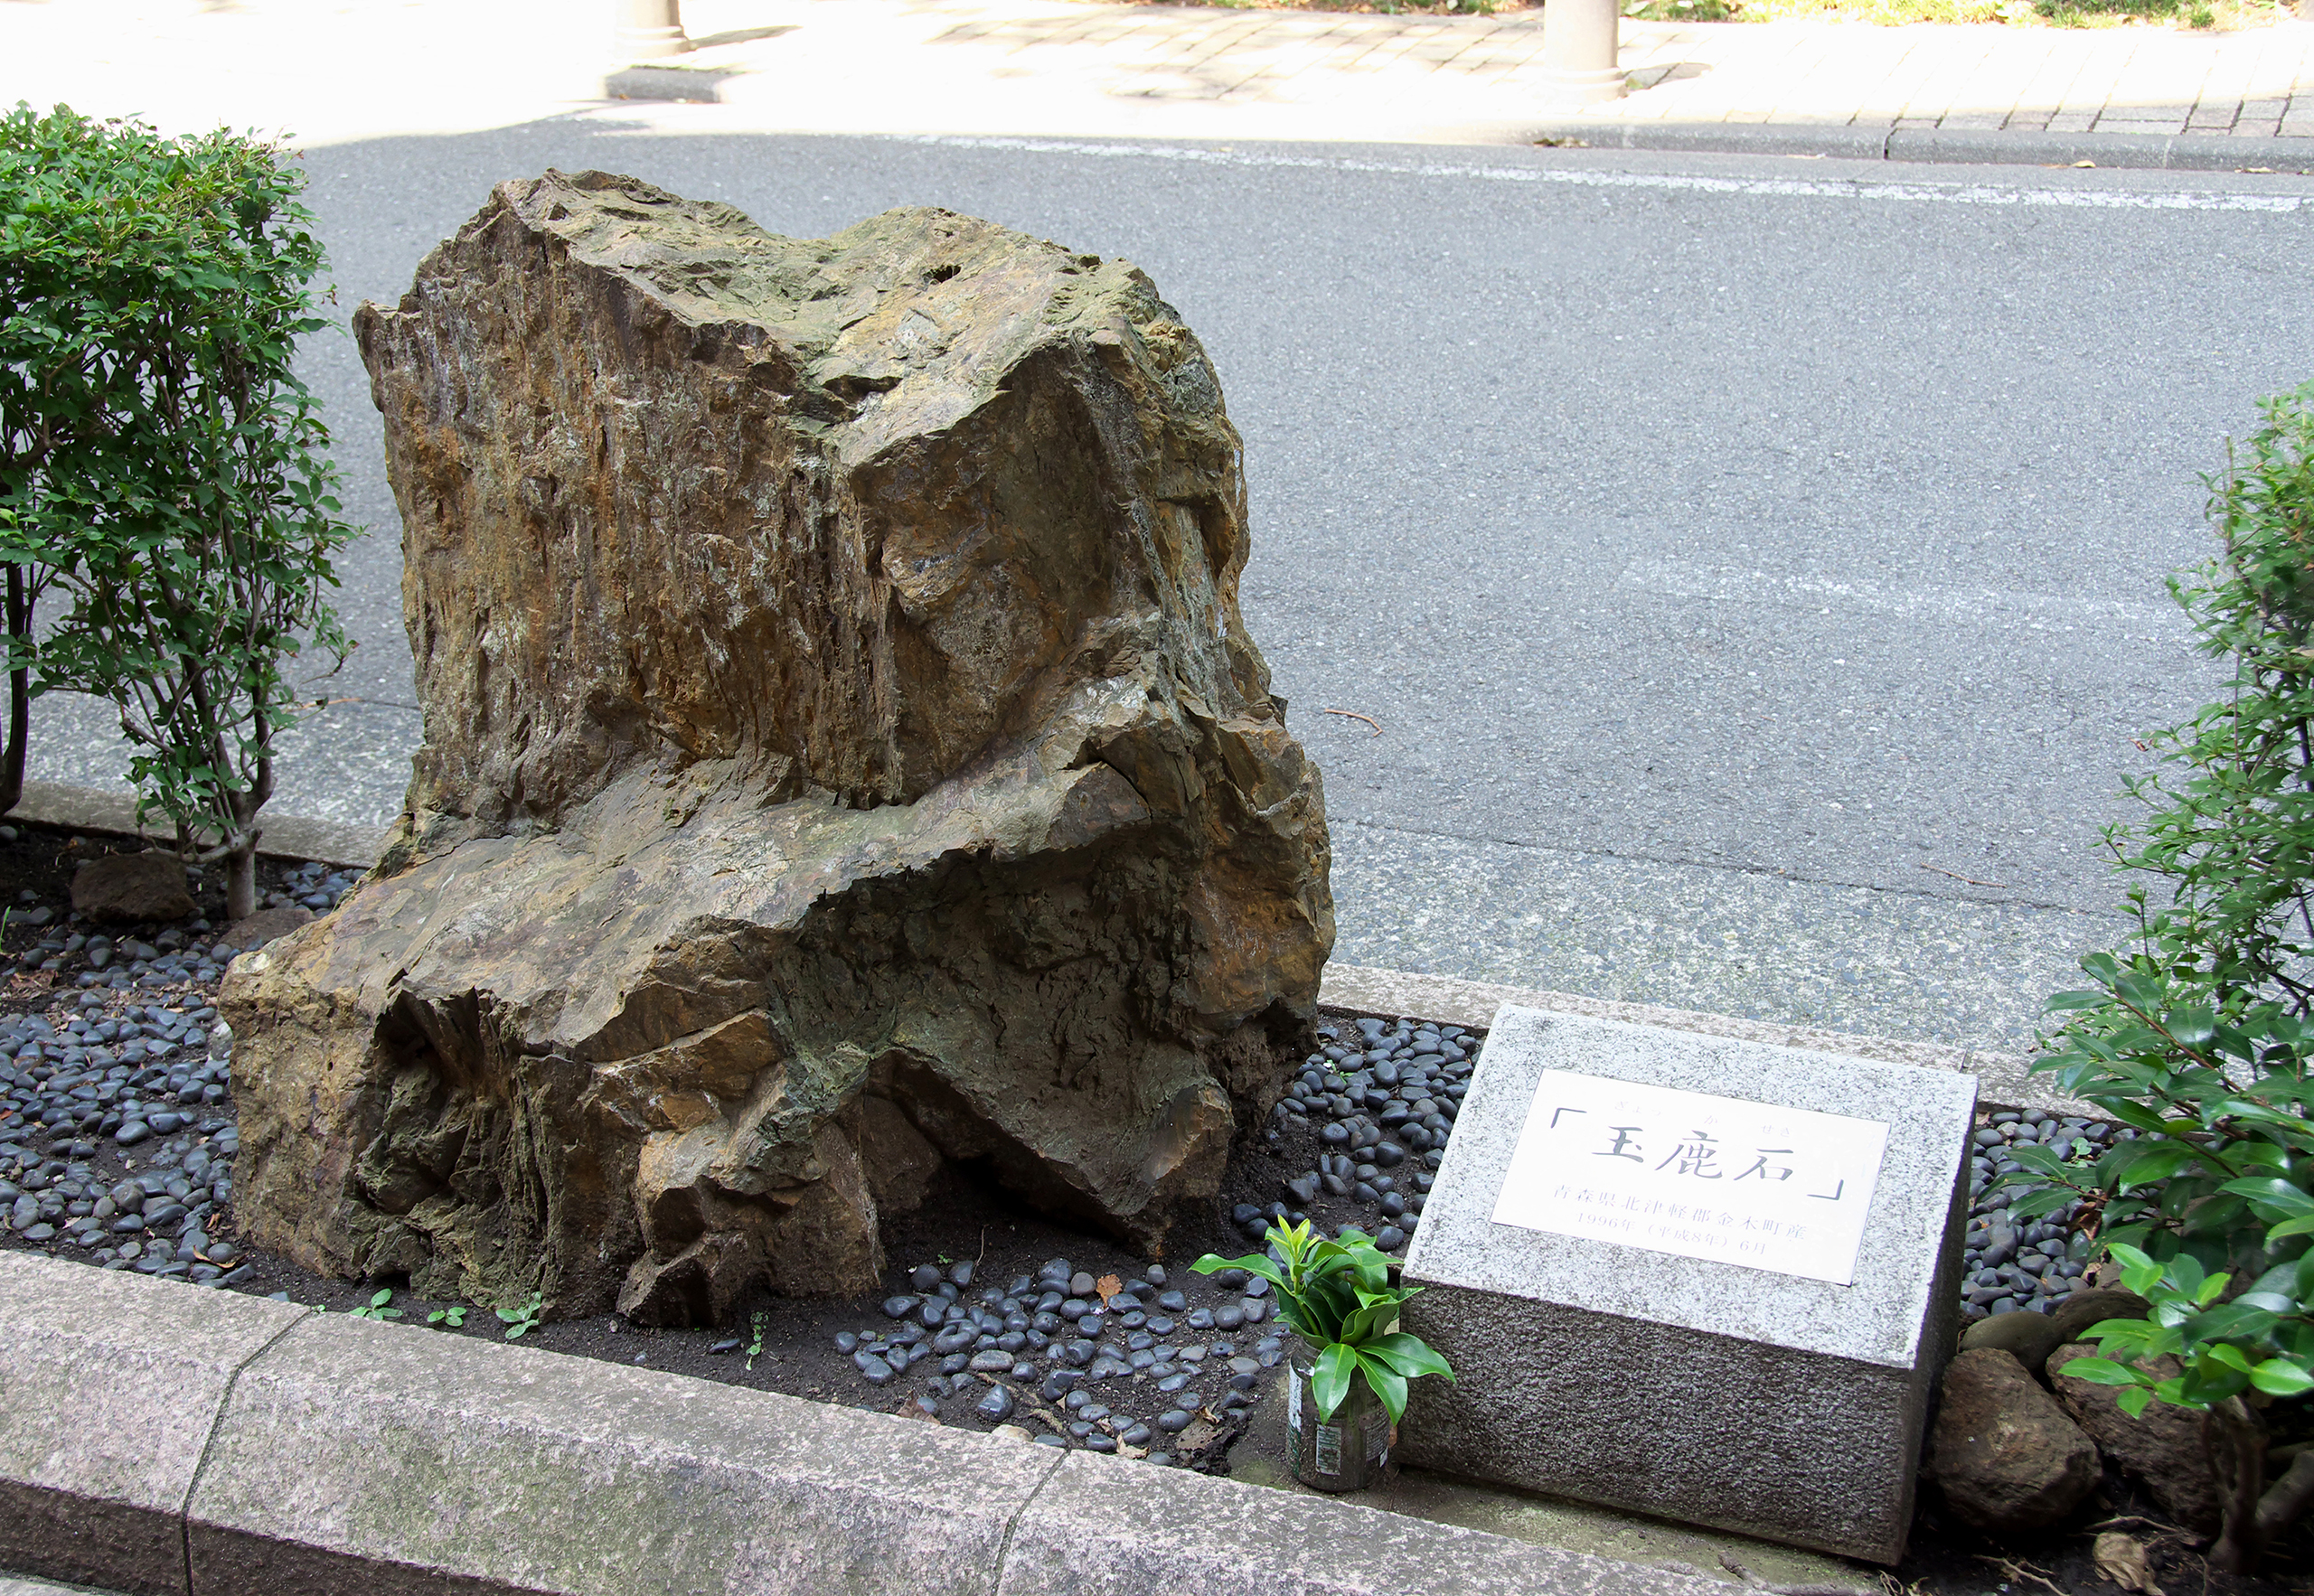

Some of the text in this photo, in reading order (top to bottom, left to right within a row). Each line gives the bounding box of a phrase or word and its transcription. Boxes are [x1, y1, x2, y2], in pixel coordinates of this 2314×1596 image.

[1549, 1106, 1845, 1201] 「玉鹿石」
[1703, 1114, 1718, 1125] か
[1760, 1124, 1792, 1138] せき
[1553, 1184, 1809, 1241] 青森県北津軽郡金木町産
